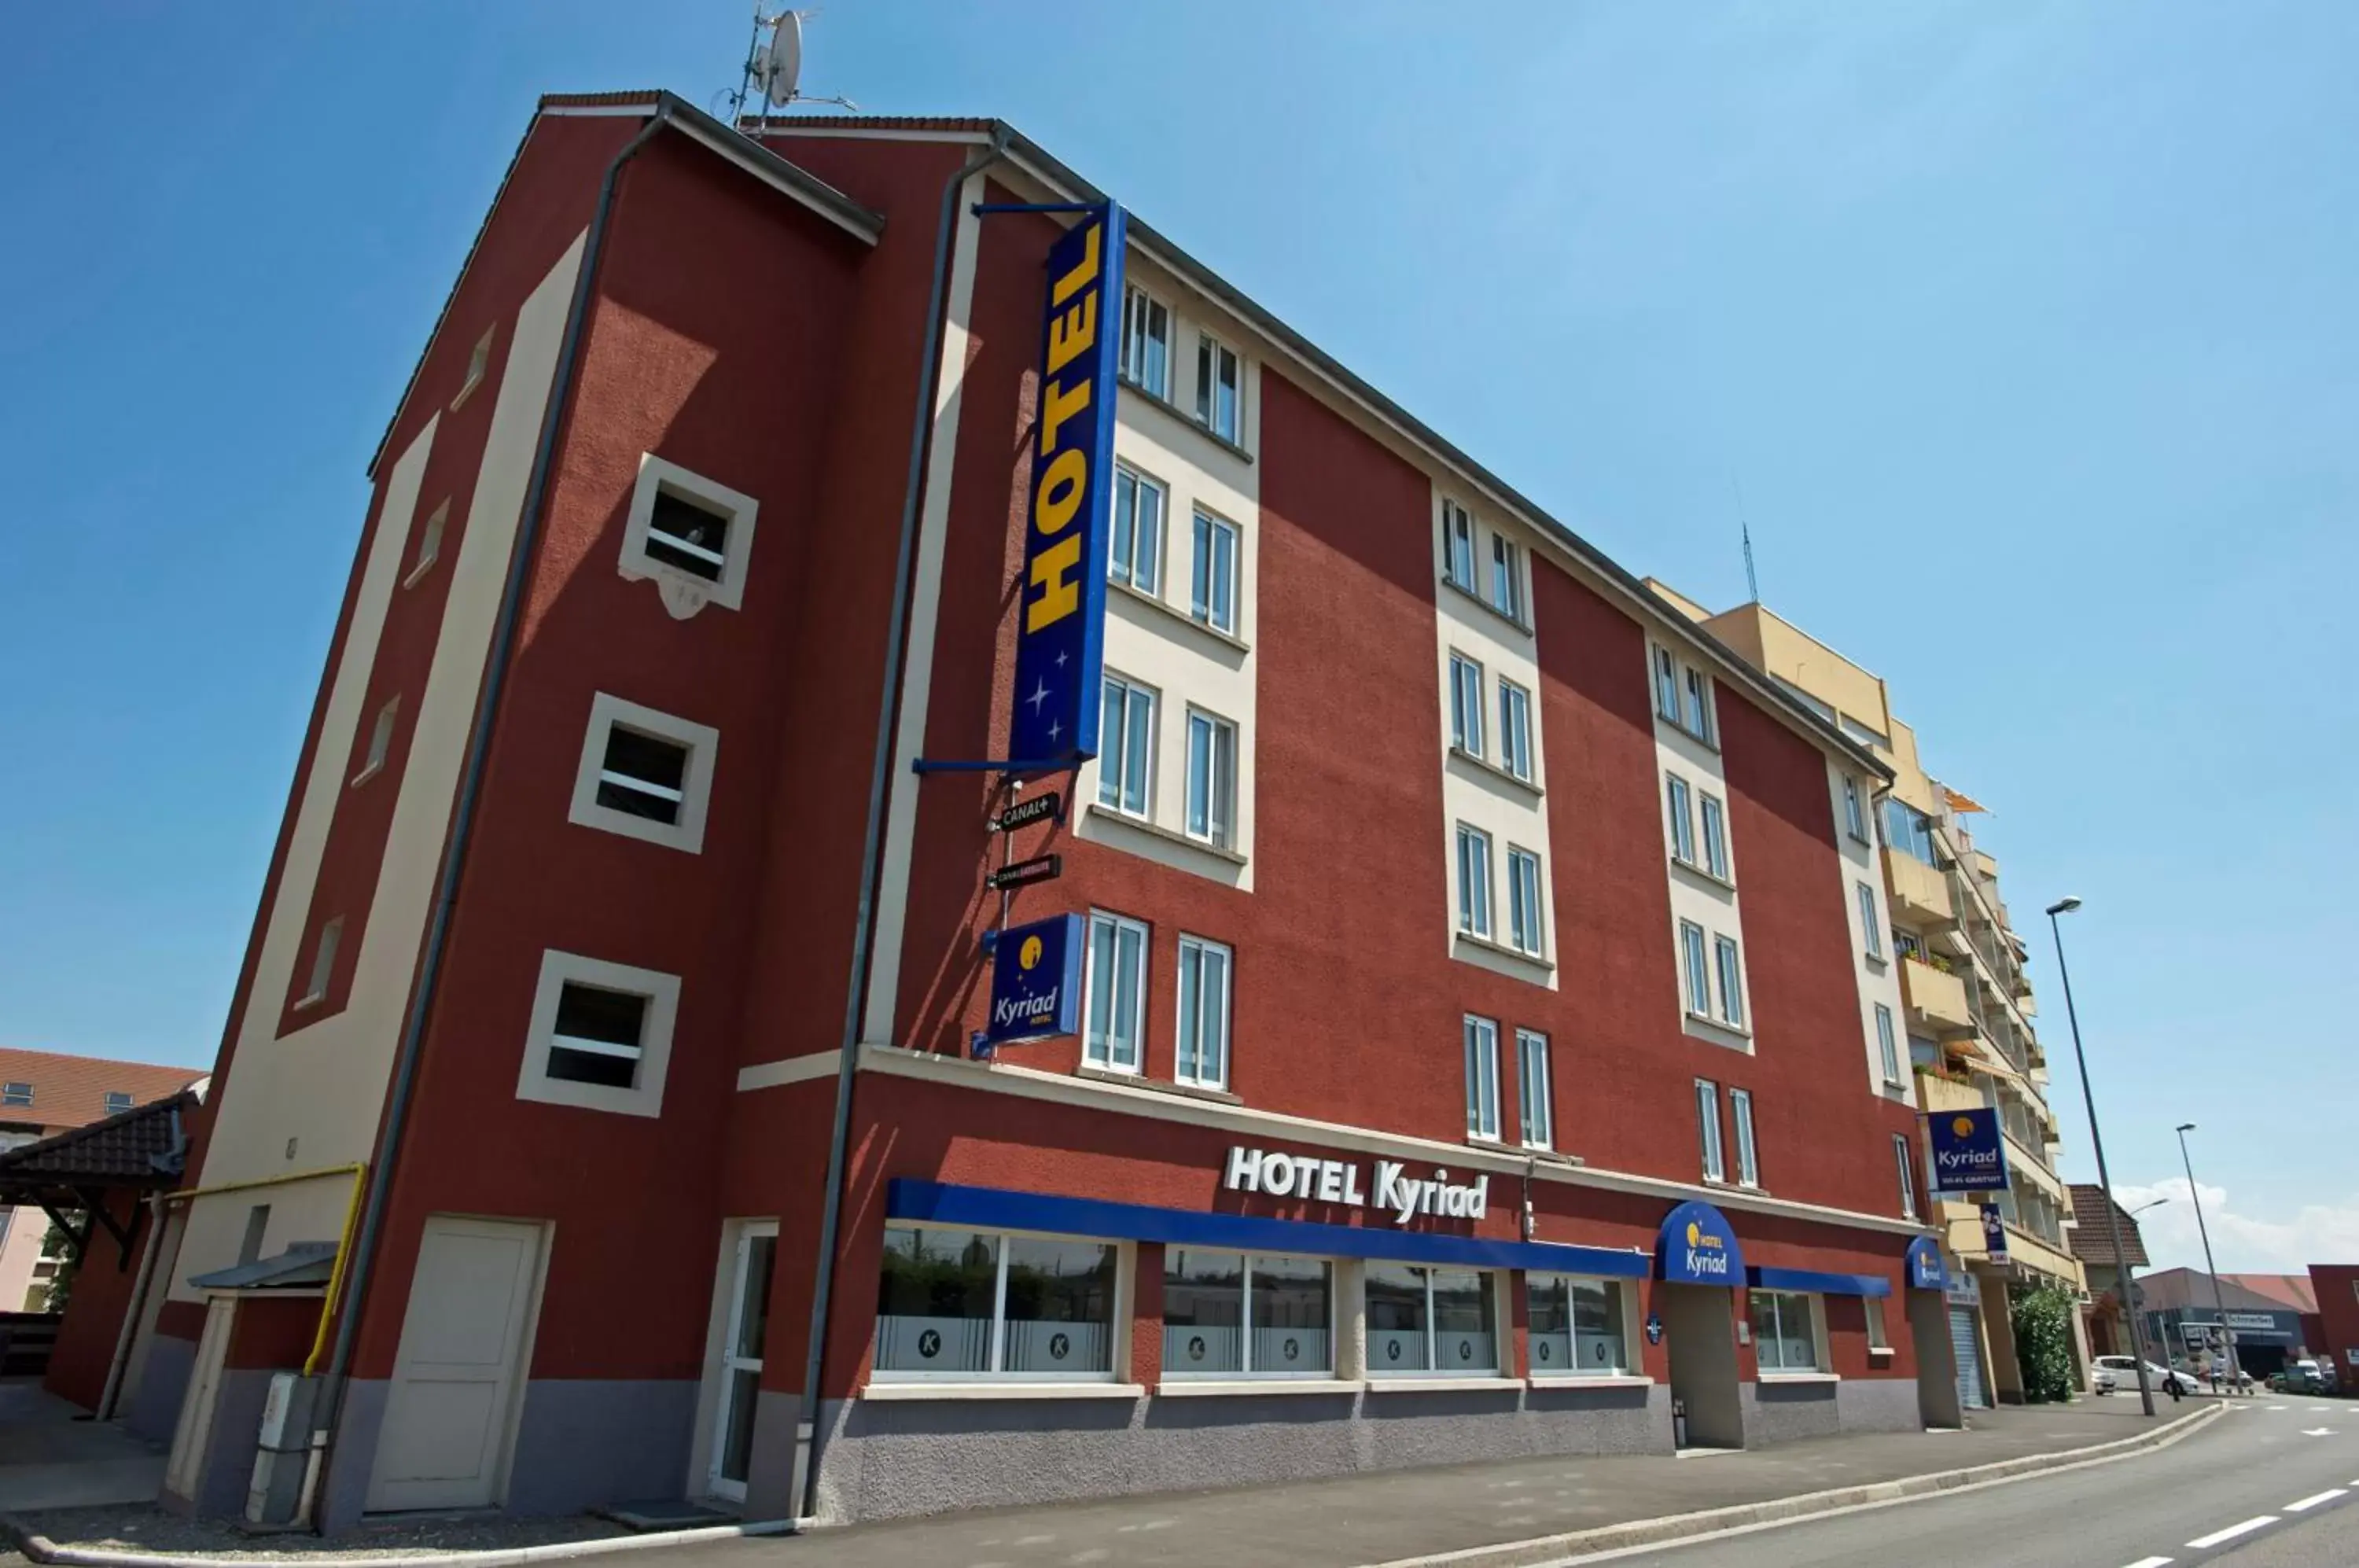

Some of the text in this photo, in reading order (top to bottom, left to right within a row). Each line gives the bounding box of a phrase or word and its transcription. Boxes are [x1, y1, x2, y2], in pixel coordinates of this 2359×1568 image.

[1027, 221, 1101, 635] HOTEL
[1003, 797, 1048, 825] CANAL+
[995, 985, 1058, 1027] Kyriad
[1938, 1148, 1997, 1169] Kyriad
[1224, 1146, 1489, 1224] HOTEL Kyriad
[1687, 1249, 1728, 1278] Kyriad
